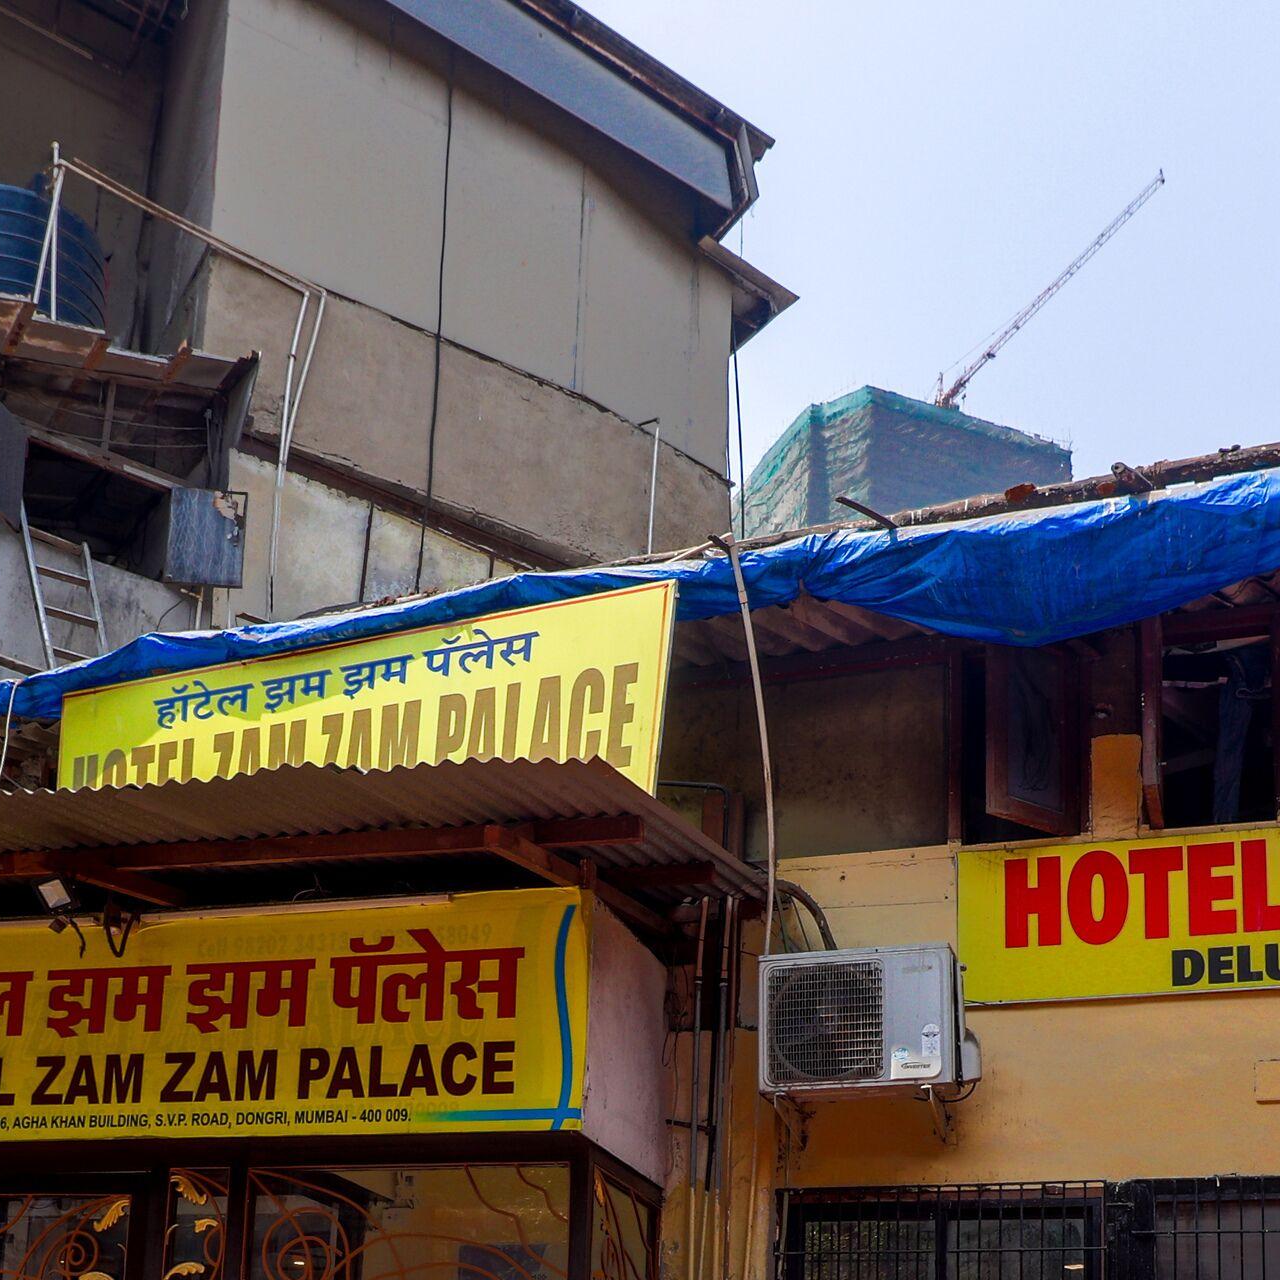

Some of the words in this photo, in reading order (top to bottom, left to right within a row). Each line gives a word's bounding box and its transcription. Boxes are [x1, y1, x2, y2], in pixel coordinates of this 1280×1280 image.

[153, 680, 255, 730] हॉटेल
[262, 669, 332, 714] झम
[339, 654, 414, 700] झम
[422, 628, 540, 677] पॅलेस
[434, 662, 639, 769] PALACE
[46, 965, 172, 1039] झम
[186, 959, 316, 1034] झम
[330, 928, 526, 1025] पॅलेस
[12, 1115, 48, 1129] AGHA
[50, 1114, 86, 1129] KHAN
[89, 1113, 152, 1129] BUILDING,
[155, 1112, 188, 1127] S.V.P.
[191, 1111, 231, 1128] ROAD,
[235, 1110, 290, 1126] DONGRI,
[294, 1109, 348, 1125] MUMBAI
[360, 1108, 382, 1122] 400
[385, 1107, 412, 1122] 009.
[31, 1053, 145, 1106] ZAM
[160, 1049, 278, 1103] ZAM
[296, 1040, 516, 1100] PALACE
